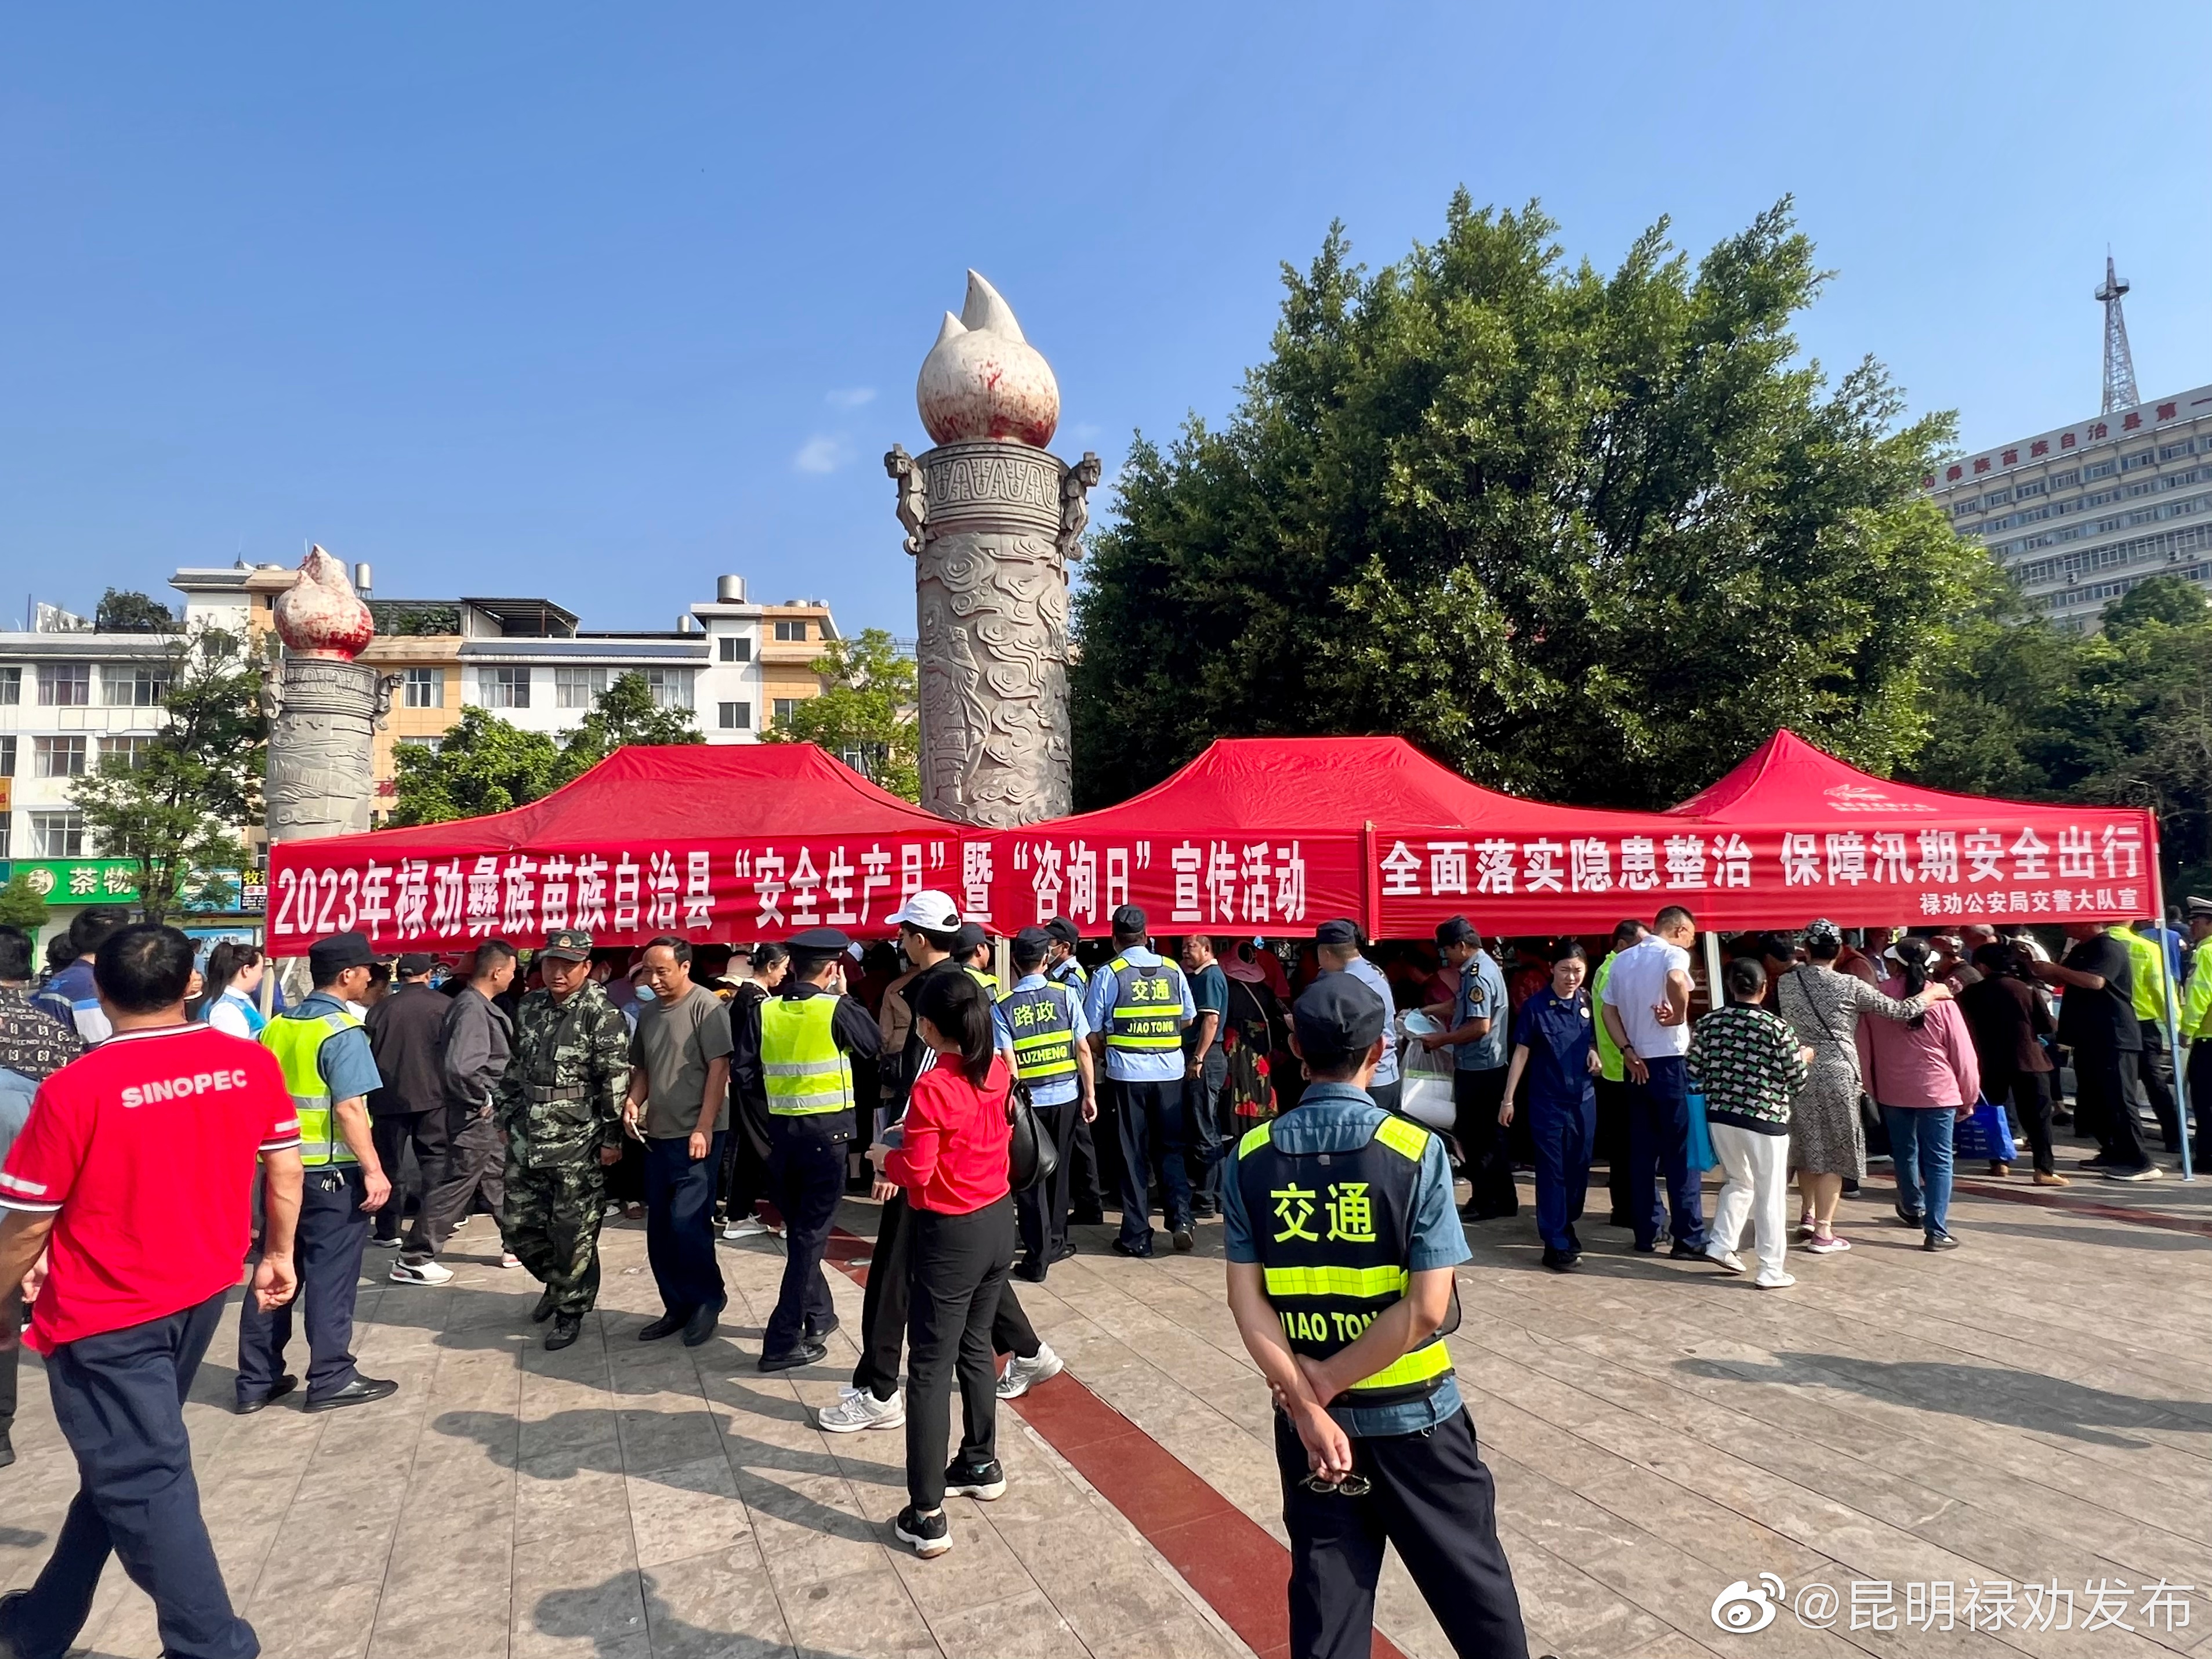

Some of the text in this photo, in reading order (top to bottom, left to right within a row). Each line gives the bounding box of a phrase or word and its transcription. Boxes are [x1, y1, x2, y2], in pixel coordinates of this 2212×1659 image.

[1380, 824, 2141, 895] 全面落实隐患整治 保障汛期安全出行
[69, 867, 166, 895] 茶物
[1920, 889, 2138, 916] 禄劝公安局交警大队宣
[1132, 979, 1170, 1001] 交通
[1013, 999, 1058, 1027] 路政
[1127, 1020, 1174, 1034] JIAO TONG
[1016, 1045, 1068, 1065] LUZHENG
[121, 1070, 248, 1108] SINOPEC
[1270, 1182, 1377, 1243] 交通
